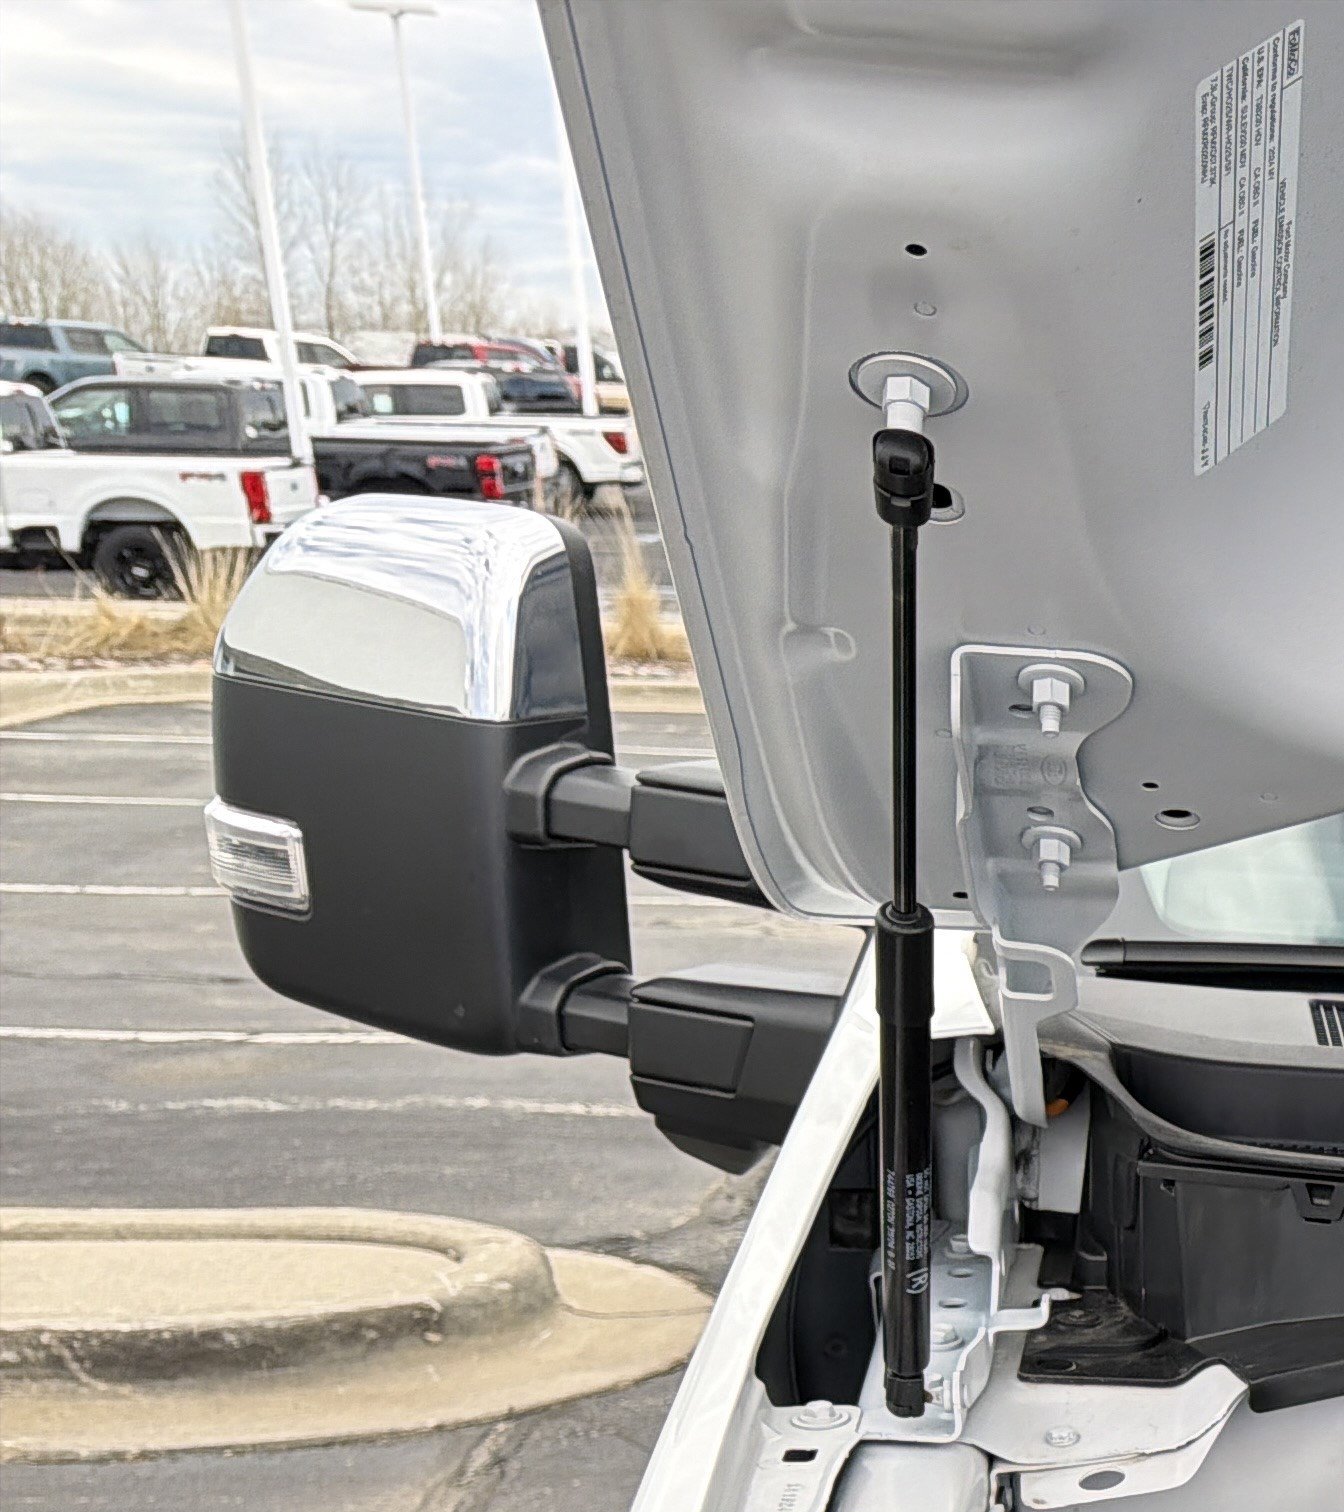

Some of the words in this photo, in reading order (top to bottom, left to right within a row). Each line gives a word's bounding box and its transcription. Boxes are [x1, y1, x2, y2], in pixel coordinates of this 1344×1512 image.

[1287, 26, 1299, 79] FoMoCo
[1240, 54, 1249, 104] California:
[1280, 261, 1290, 301] Company
